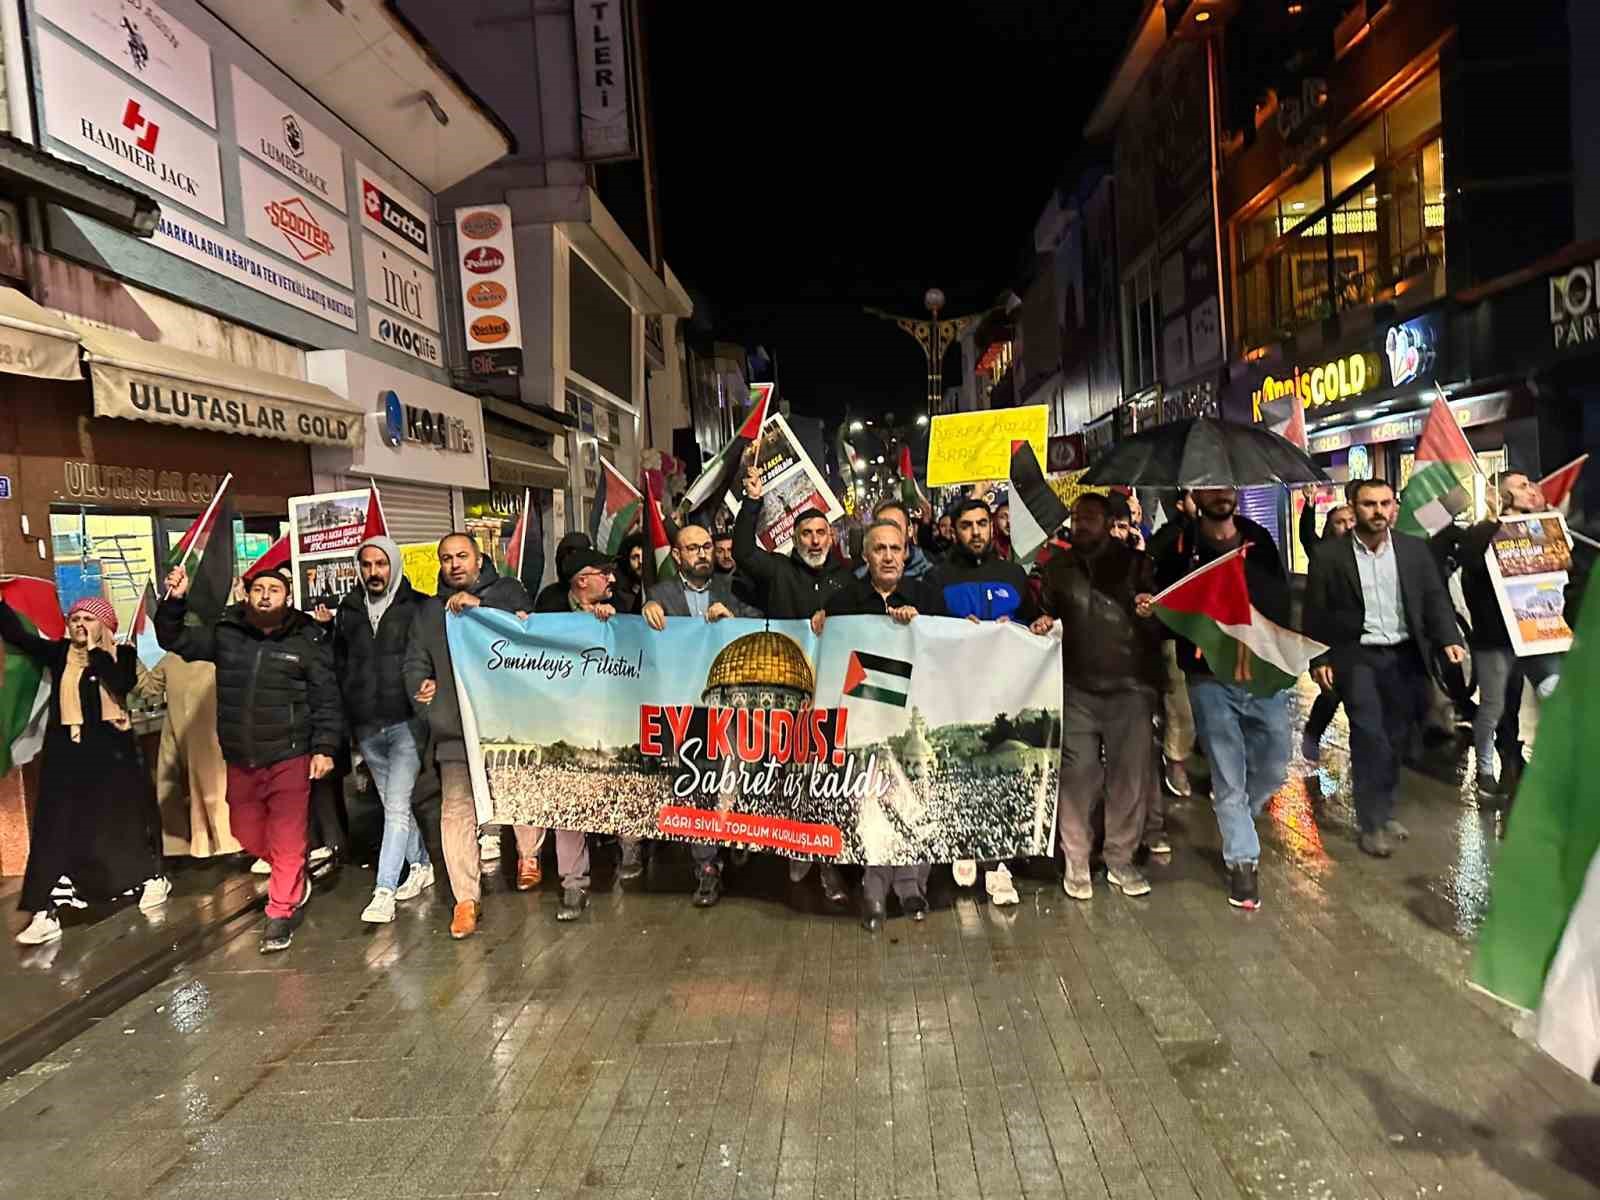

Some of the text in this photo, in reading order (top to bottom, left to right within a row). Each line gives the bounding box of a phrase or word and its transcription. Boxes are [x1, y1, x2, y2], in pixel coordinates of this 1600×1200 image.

[81, 117, 198, 196] HAMMER JACK
[260, 138, 329, 195] LUMBERJACK
[270, 201, 331, 252] SCOOTER
[129, 382, 348, 441] ULUTAŞLAR GOLD
[64, 461, 186, 505] ULUTAŞLAR
[580, 647, 644, 679] Filistin!
[640, 702, 849, 767] EY KUDÜS!
[673, 737, 892, 809] Sabret az kaldı
[663, 813, 834, 850] AĞRI SİVİL TOPLUM KURULUŞLARI
